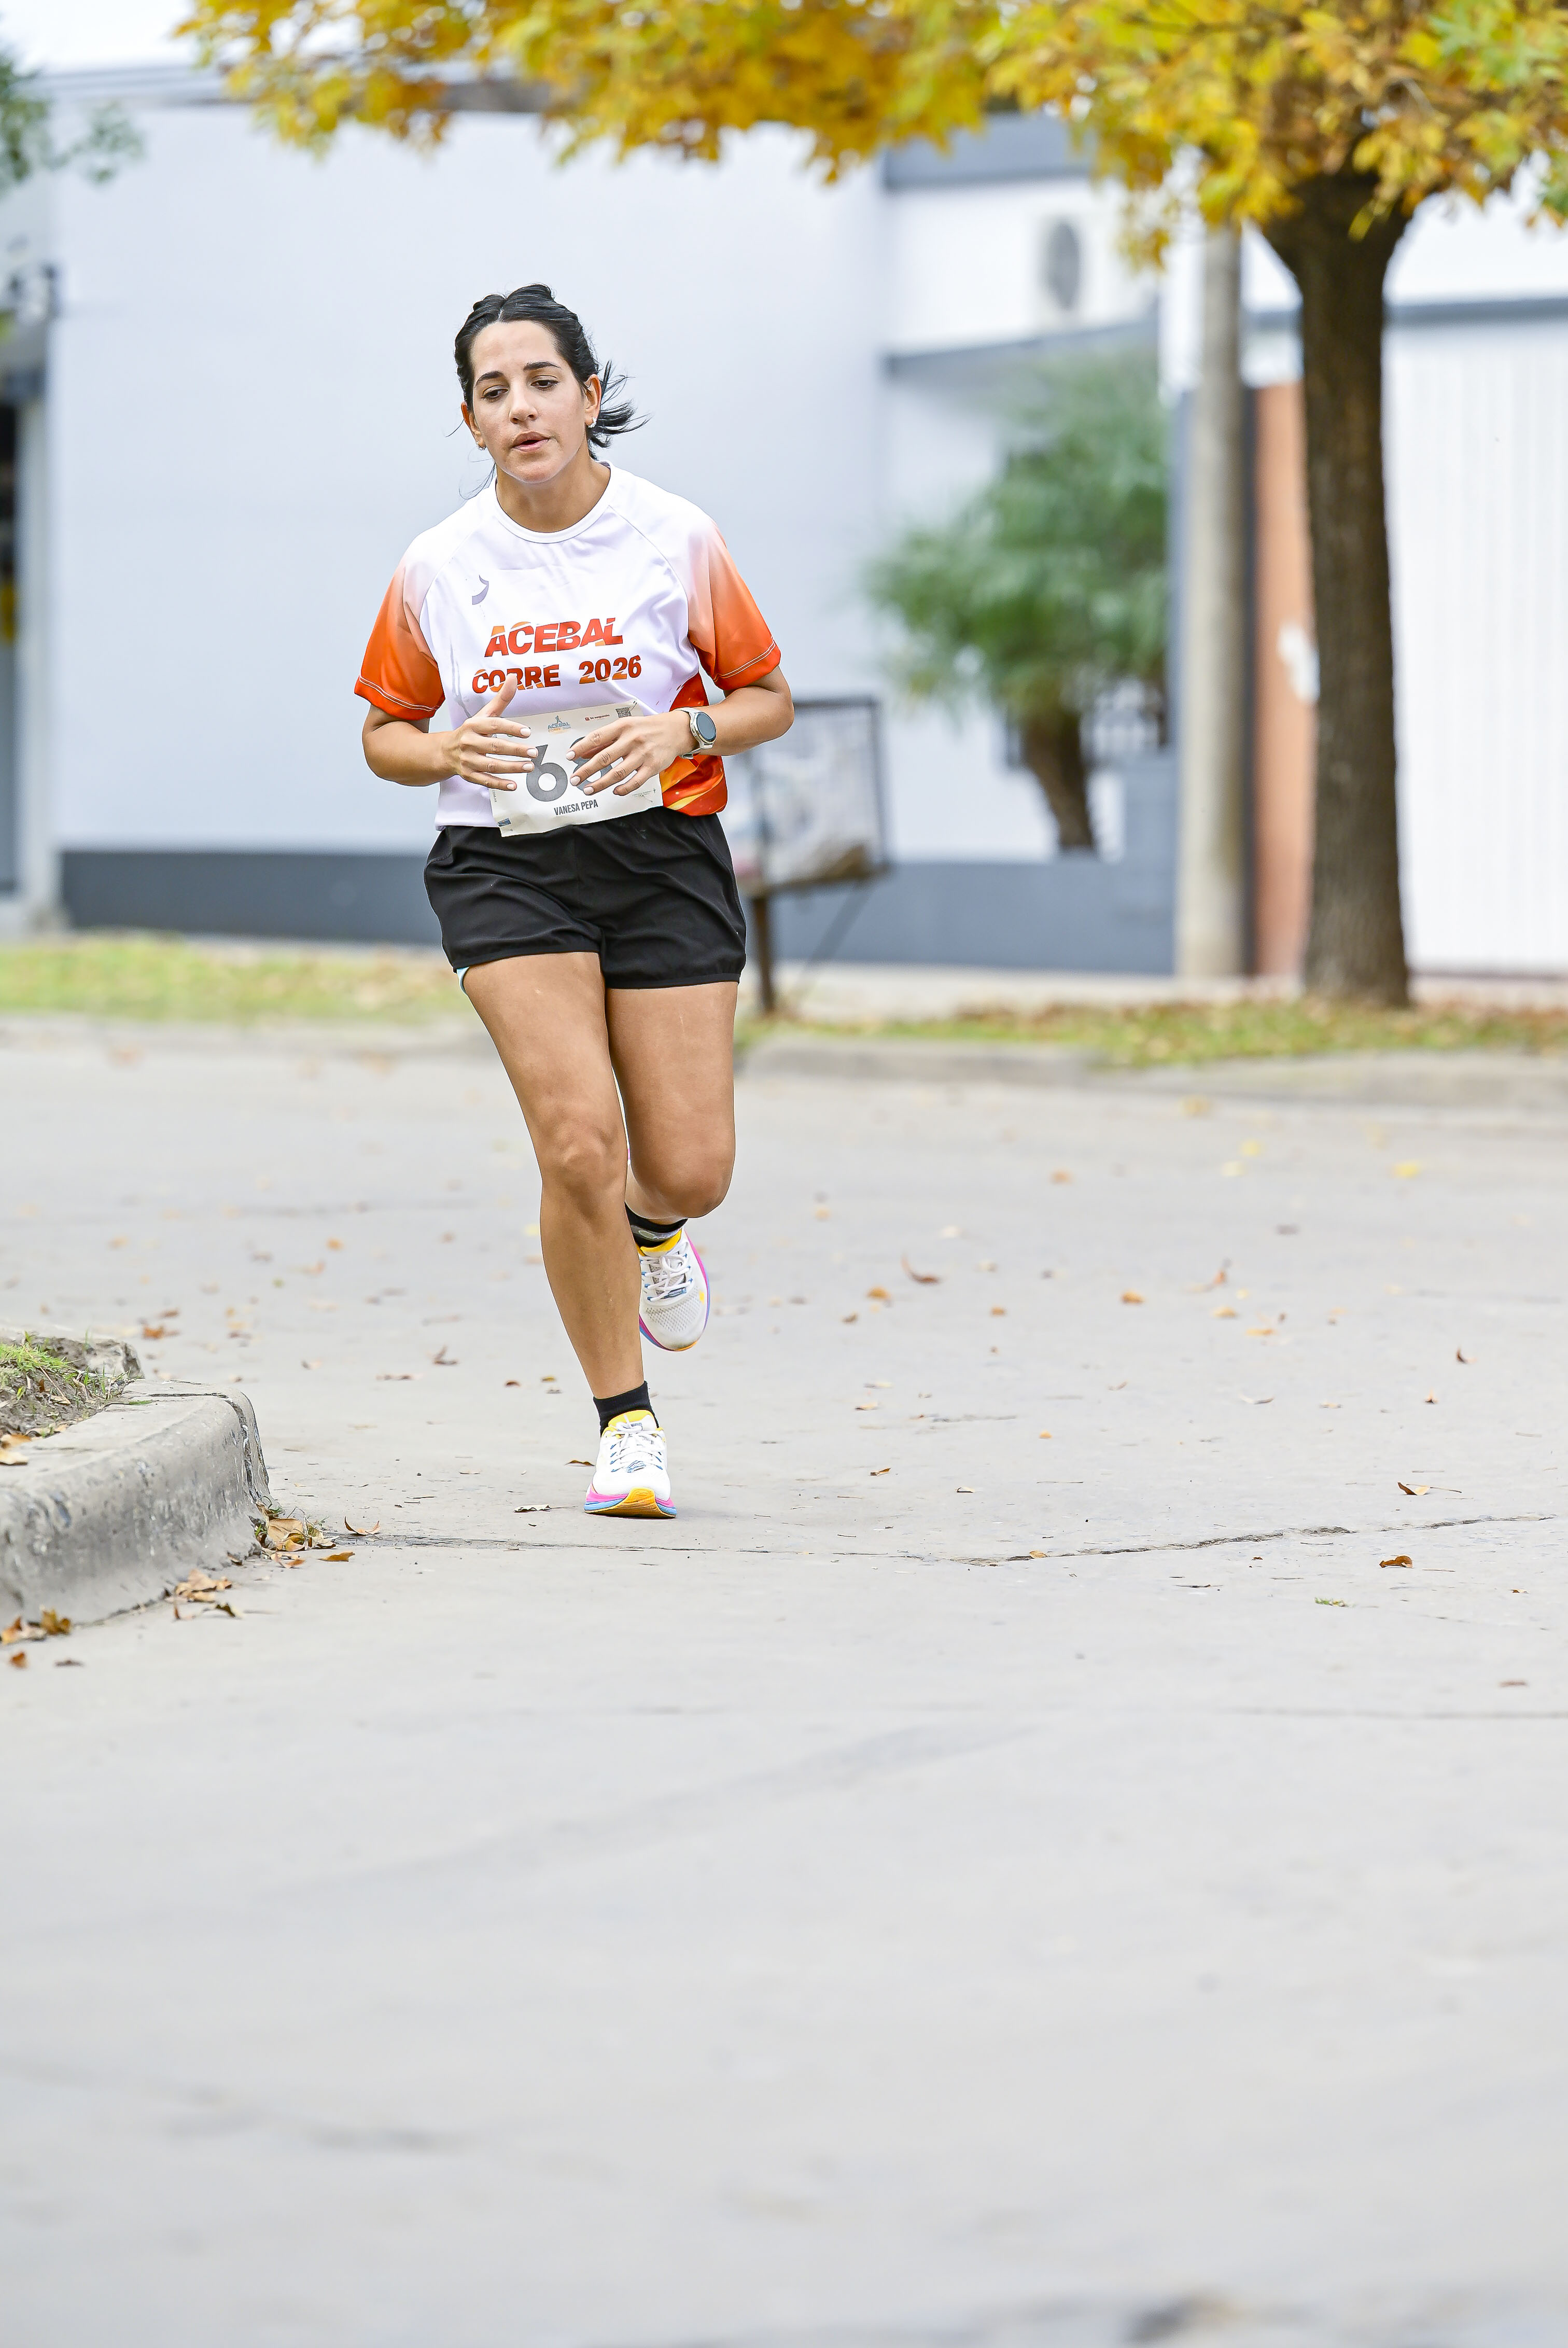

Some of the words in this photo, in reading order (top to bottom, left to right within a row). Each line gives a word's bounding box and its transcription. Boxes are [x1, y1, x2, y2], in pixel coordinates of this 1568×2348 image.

[484, 618, 623, 657] ACEBAL
[579, 655, 641, 684] 2026
[554, 803, 580, 816] VANESA
[581, 799, 598, 810] PEPA
